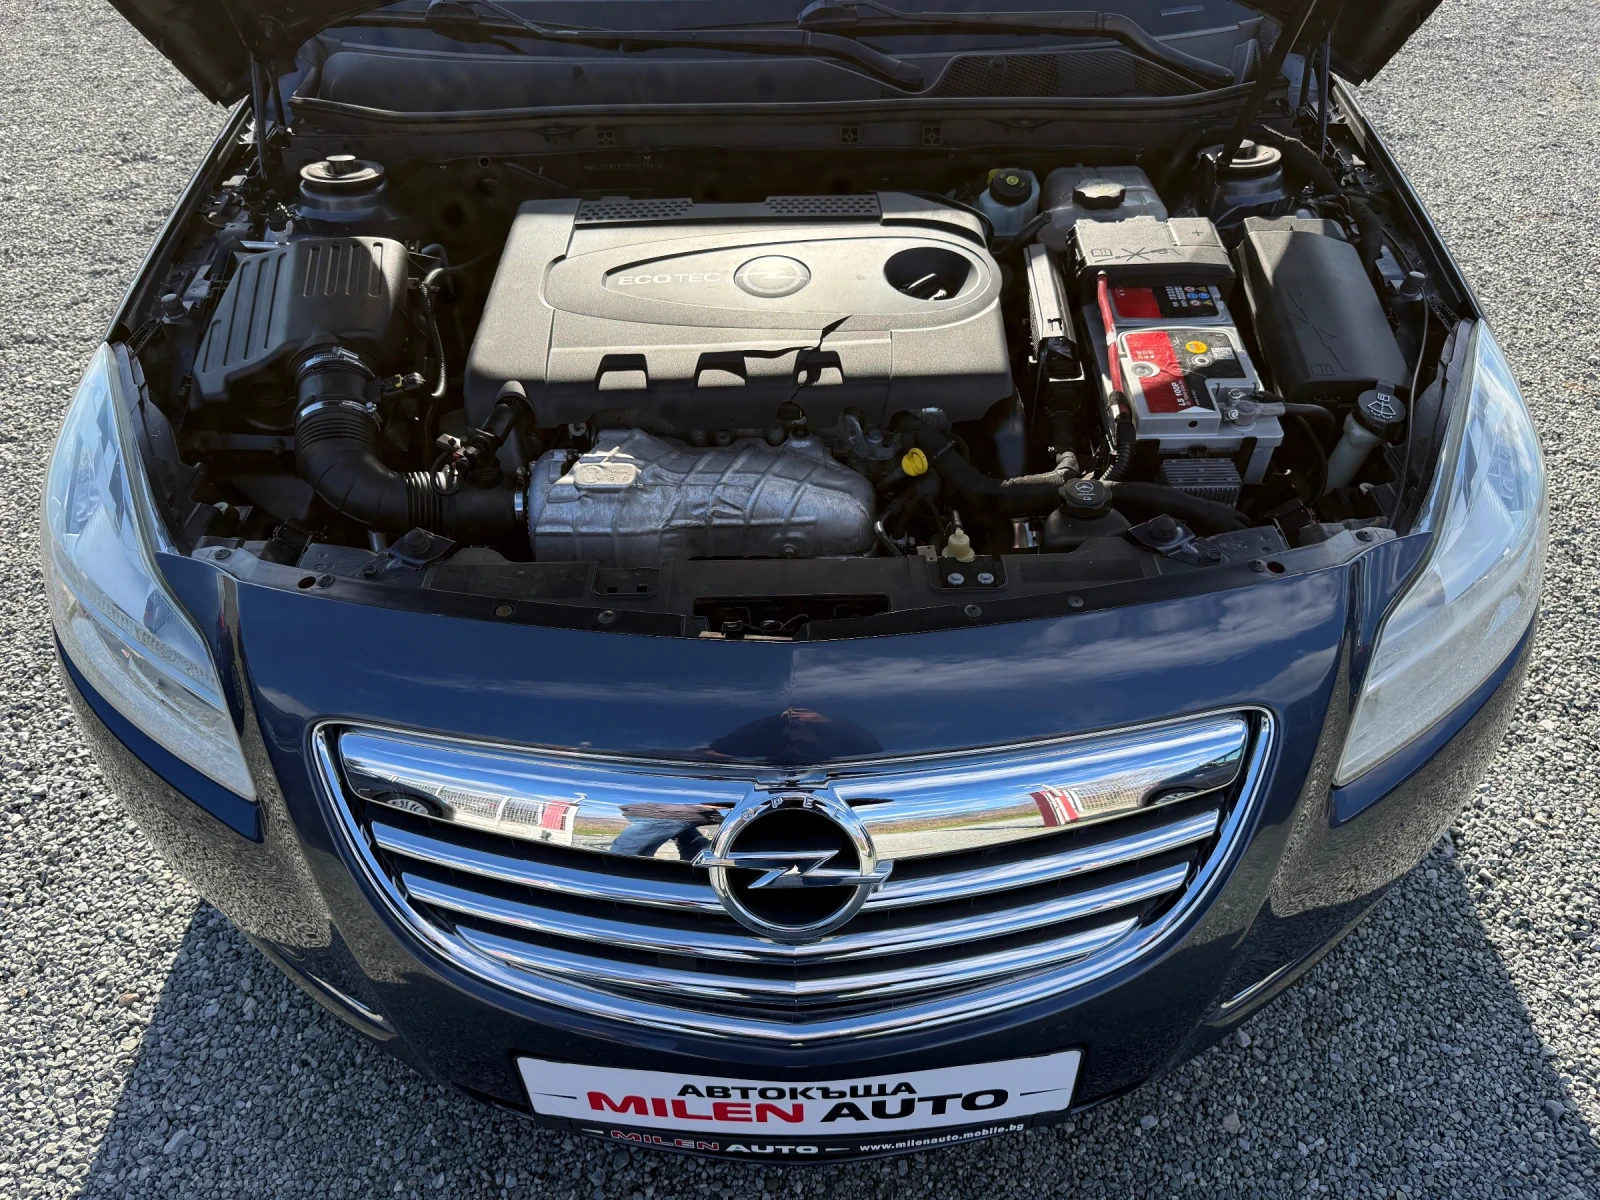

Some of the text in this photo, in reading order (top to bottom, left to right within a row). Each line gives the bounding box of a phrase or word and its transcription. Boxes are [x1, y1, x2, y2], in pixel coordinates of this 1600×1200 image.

[618, 271, 723, 286] ECOTEC
[741, 796, 844, 820] OPEL
[677, 1081, 918, 1101] АВТОКЪША
[586, 1088, 1009, 1124] MILEN AUTO
[610, 1122, 1025, 1154] MILEN AUTO www.milenauto.mobile.bg
